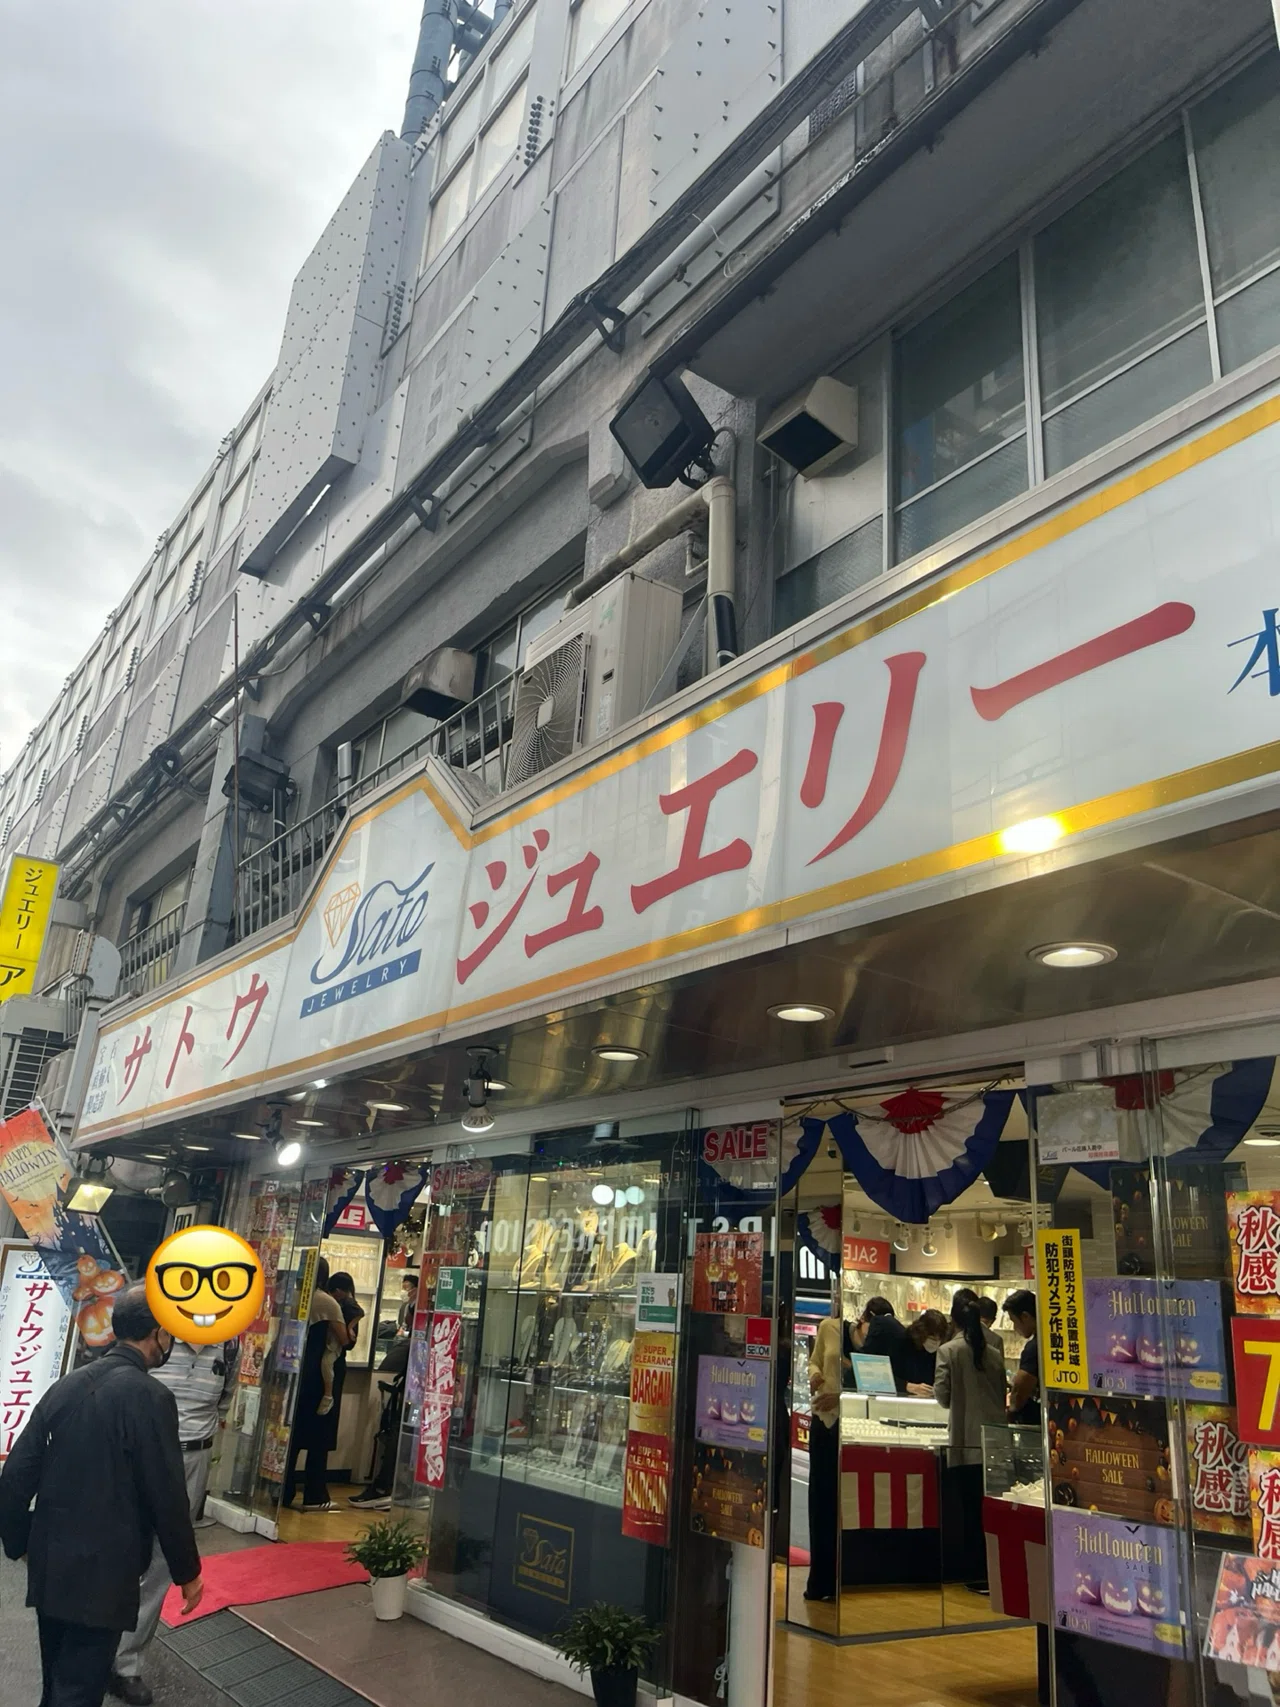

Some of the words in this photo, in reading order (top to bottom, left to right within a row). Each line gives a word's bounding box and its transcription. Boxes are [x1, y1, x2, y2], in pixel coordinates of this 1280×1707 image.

[456, 601, 1196, 985] ジュエリー
[16, 868, 43, 949] ジュエリー
[310, 862, 437, 984] Sato
[307, 959, 408, 1013] JEWELRY
[117, 973, 270, 1106] サトウ
[4, 1145, 32, 1166] HAPPY
[704, 1126, 768, 1163] SALE
[0, 1147, 58, 1187] HALLOWEEN
[1045, 1243, 1065, 1365] 防犯カメラ作動中
[1062, 1235, 1080, 1366] 街頭防犯カメラ設置地域
[3, 1282, 53, 1453] サトウジュエリー
[643, 1344, 667, 1356] SUPER
[747, 1345, 770, 1356] SECOM
[711, 1364, 757, 1388] Halloween
[638, 1446, 662, 1458] SUPER
[1085, 1448, 1139, 1469] HALLOWEEN
[1102, 1468, 1124, 1485] SALE
[1074, 1526, 1162, 1566] Halloween
[1126, 1561, 1152, 1574] SALE
